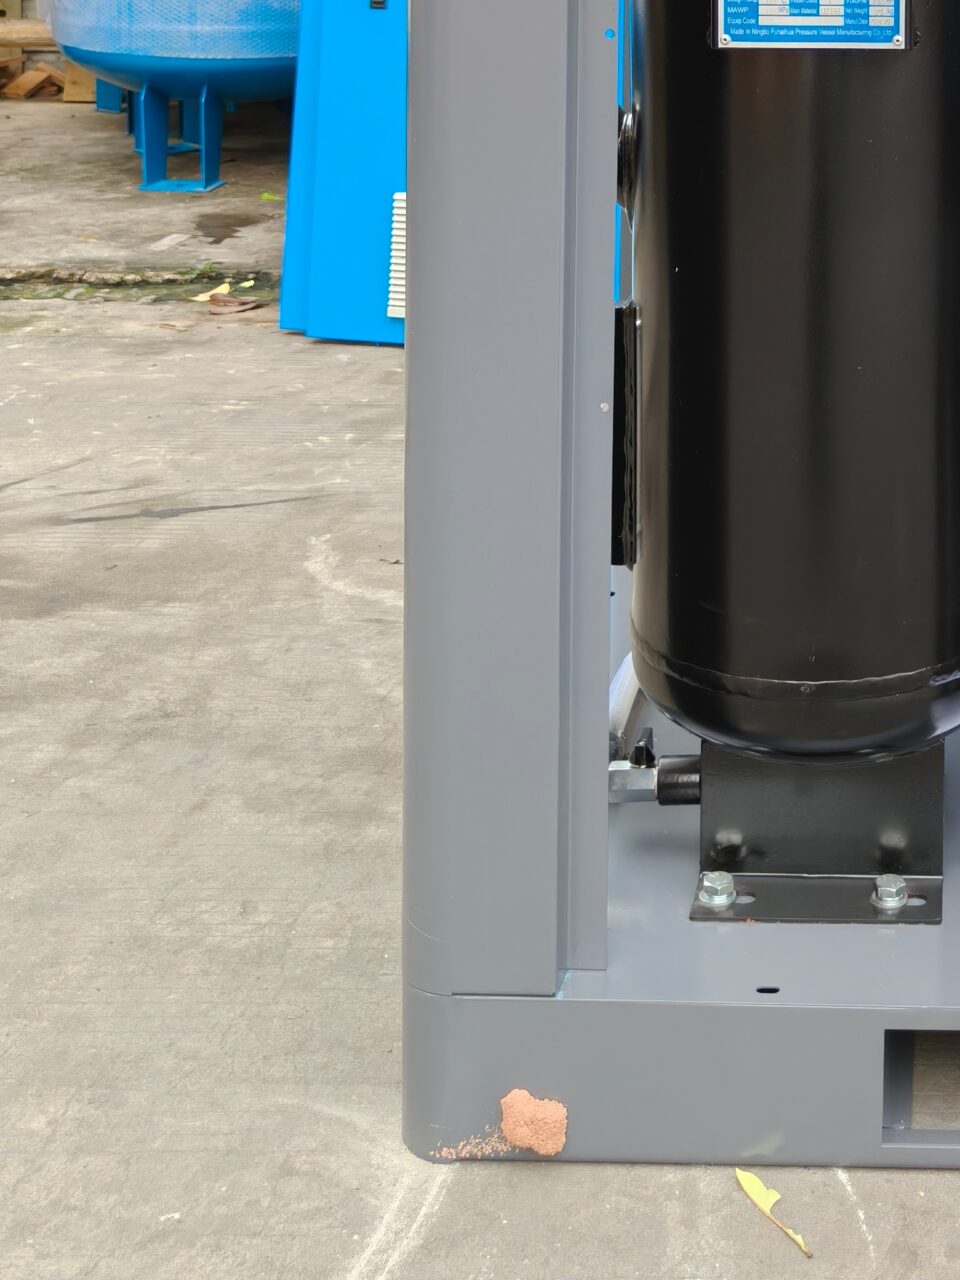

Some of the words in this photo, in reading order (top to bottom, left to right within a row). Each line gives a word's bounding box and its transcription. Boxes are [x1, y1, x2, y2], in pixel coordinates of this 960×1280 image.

[751, 28, 769, 36] Ningbo
[795, 28, 817, 36] Pressure
[836, 29, 872, 37] Manufacturing
